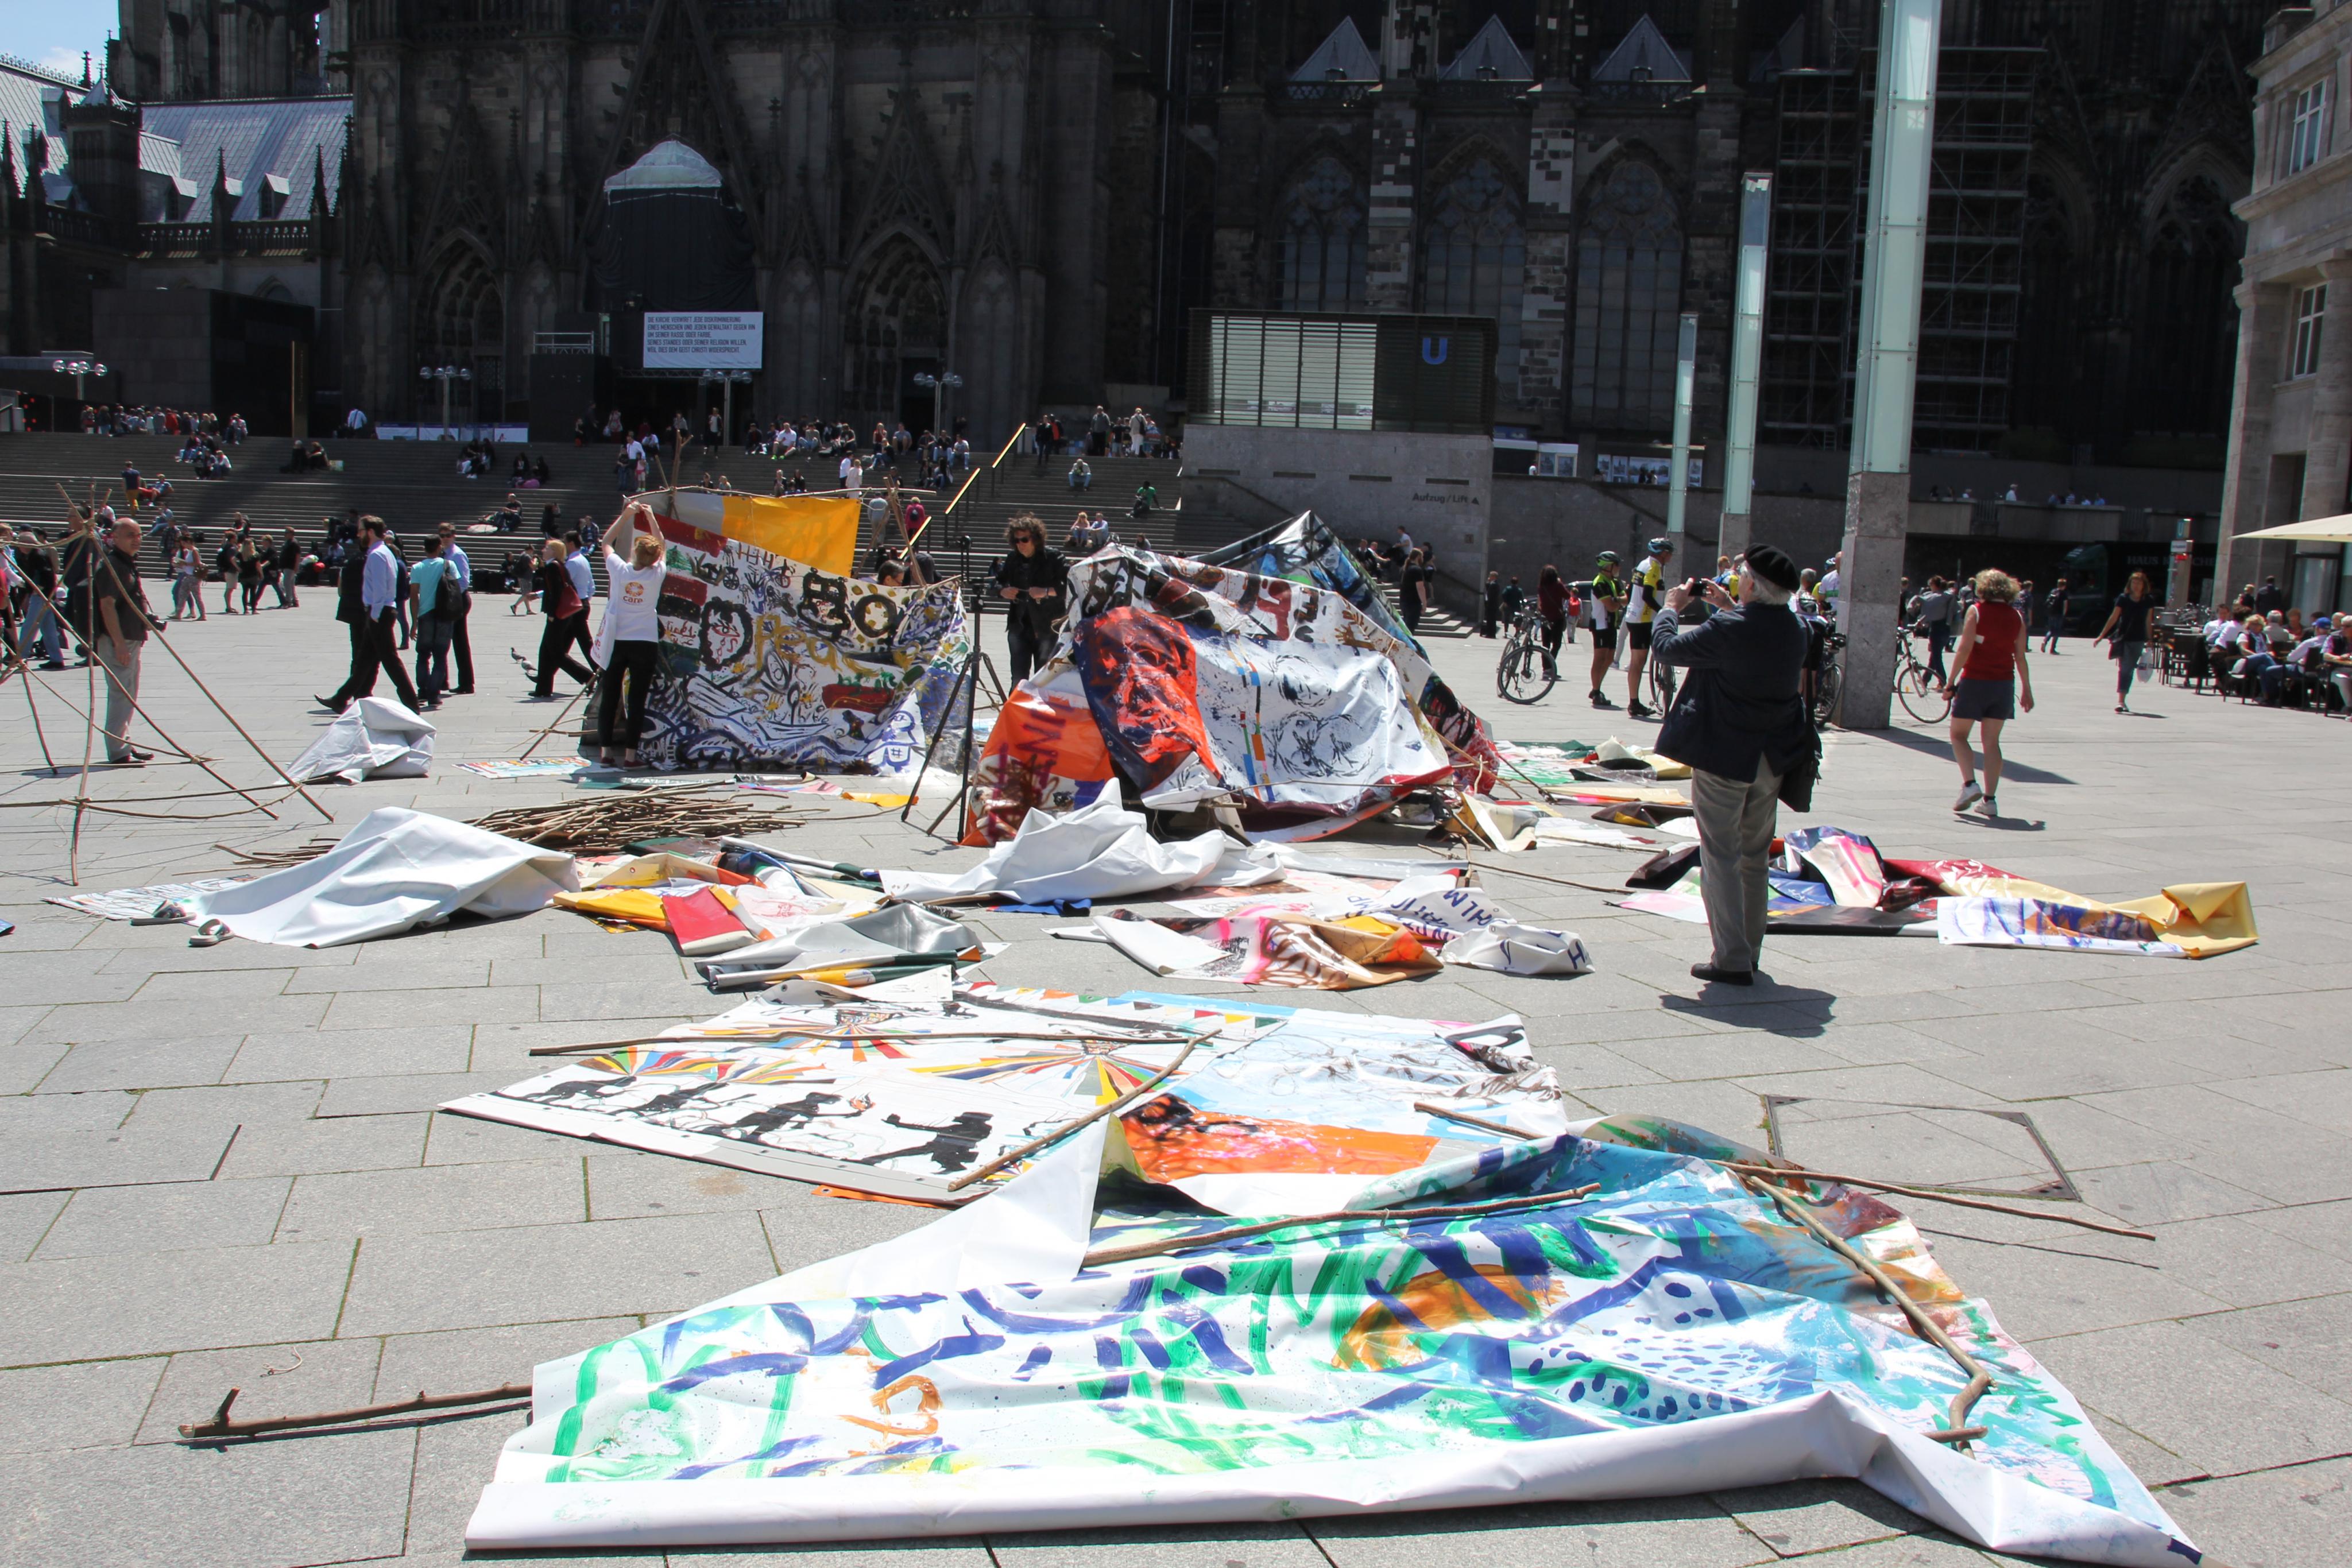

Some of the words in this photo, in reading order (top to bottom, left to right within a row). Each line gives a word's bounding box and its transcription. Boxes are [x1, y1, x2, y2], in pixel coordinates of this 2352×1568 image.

[1422, 338, 1448, 365] U
[1413, 493, 1445, 504] Aufzug
[1452, 495, 1468, 503] Lift
[2177, 521, 2184, 536] U
[2127, 556, 2159, 565] HAUS
